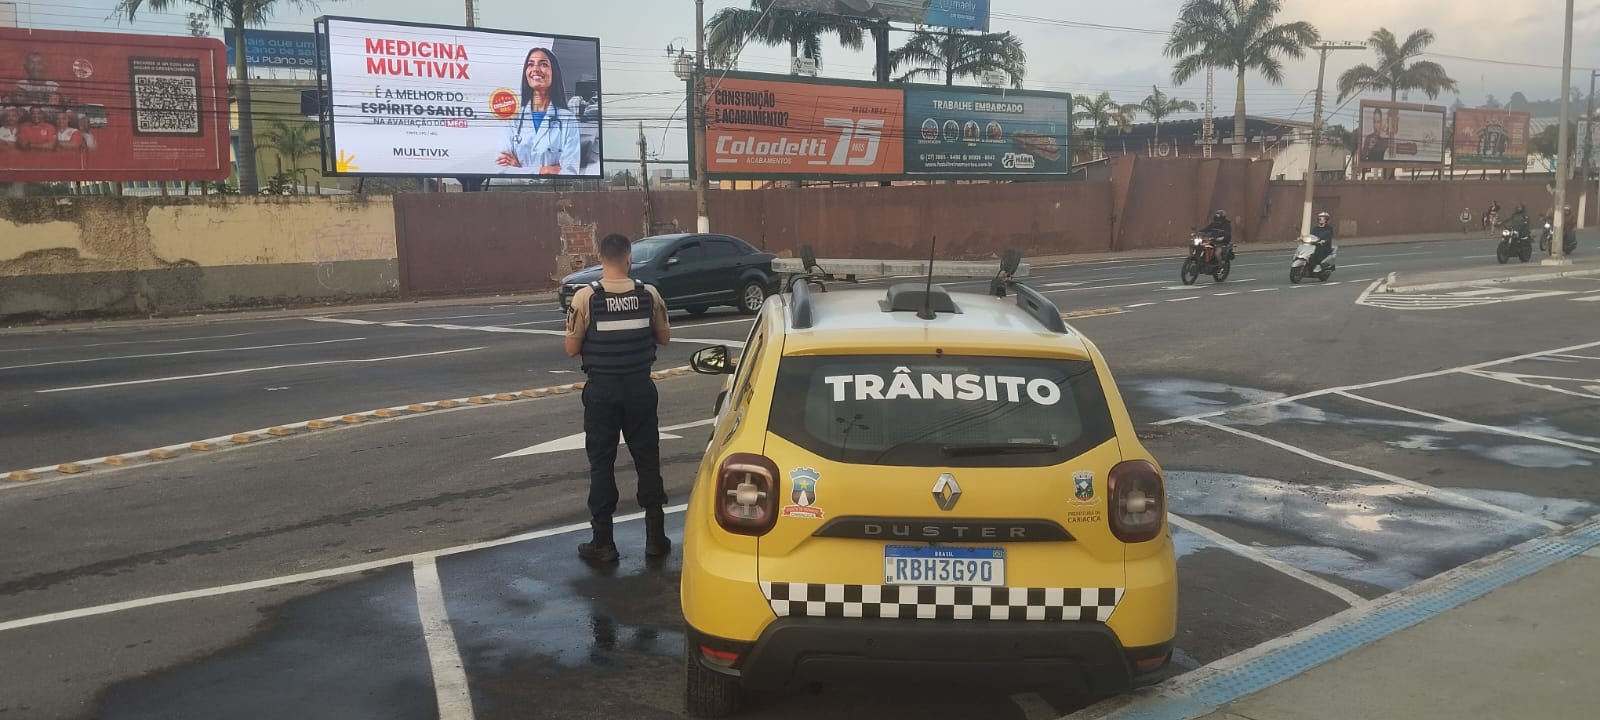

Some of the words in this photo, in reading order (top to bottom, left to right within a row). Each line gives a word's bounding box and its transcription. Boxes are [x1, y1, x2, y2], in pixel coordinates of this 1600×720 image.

[365, 38, 468, 61] MEDICINA
[367, 57, 470, 80] MULTIVIX
[375, 85, 382, 99] É
[385, 89, 394, 99] A
[396, 90, 443, 102] MELHOR
[446, 92, 464, 102] DO
[715, 90, 775, 110] CONSTRUÇÃO
[361, 100, 424, 116] ESPÍRITO
[427, 105, 478, 120] SANTO,
[932, 100, 973, 111] TRABALHE
[974, 102, 1024, 113] EMBARCADO
[388, 117, 433, 129] AVALIAÇÃO
[722, 108, 789, 126] ACABAMENTO?
[715, 135, 827, 156] Colodetti
[823, 117, 885, 166] 75
[393, 147, 449, 157] MULTIVIX
[746, 157, 792, 165] ACABAMENTOS
[825, 366, 1061, 405] TRÂNSITO
[1067, 515, 1101, 523] CARIACICA
[864, 524, 1026, 537] DUSTER
[896, 559, 992, 582] RBH3G90
